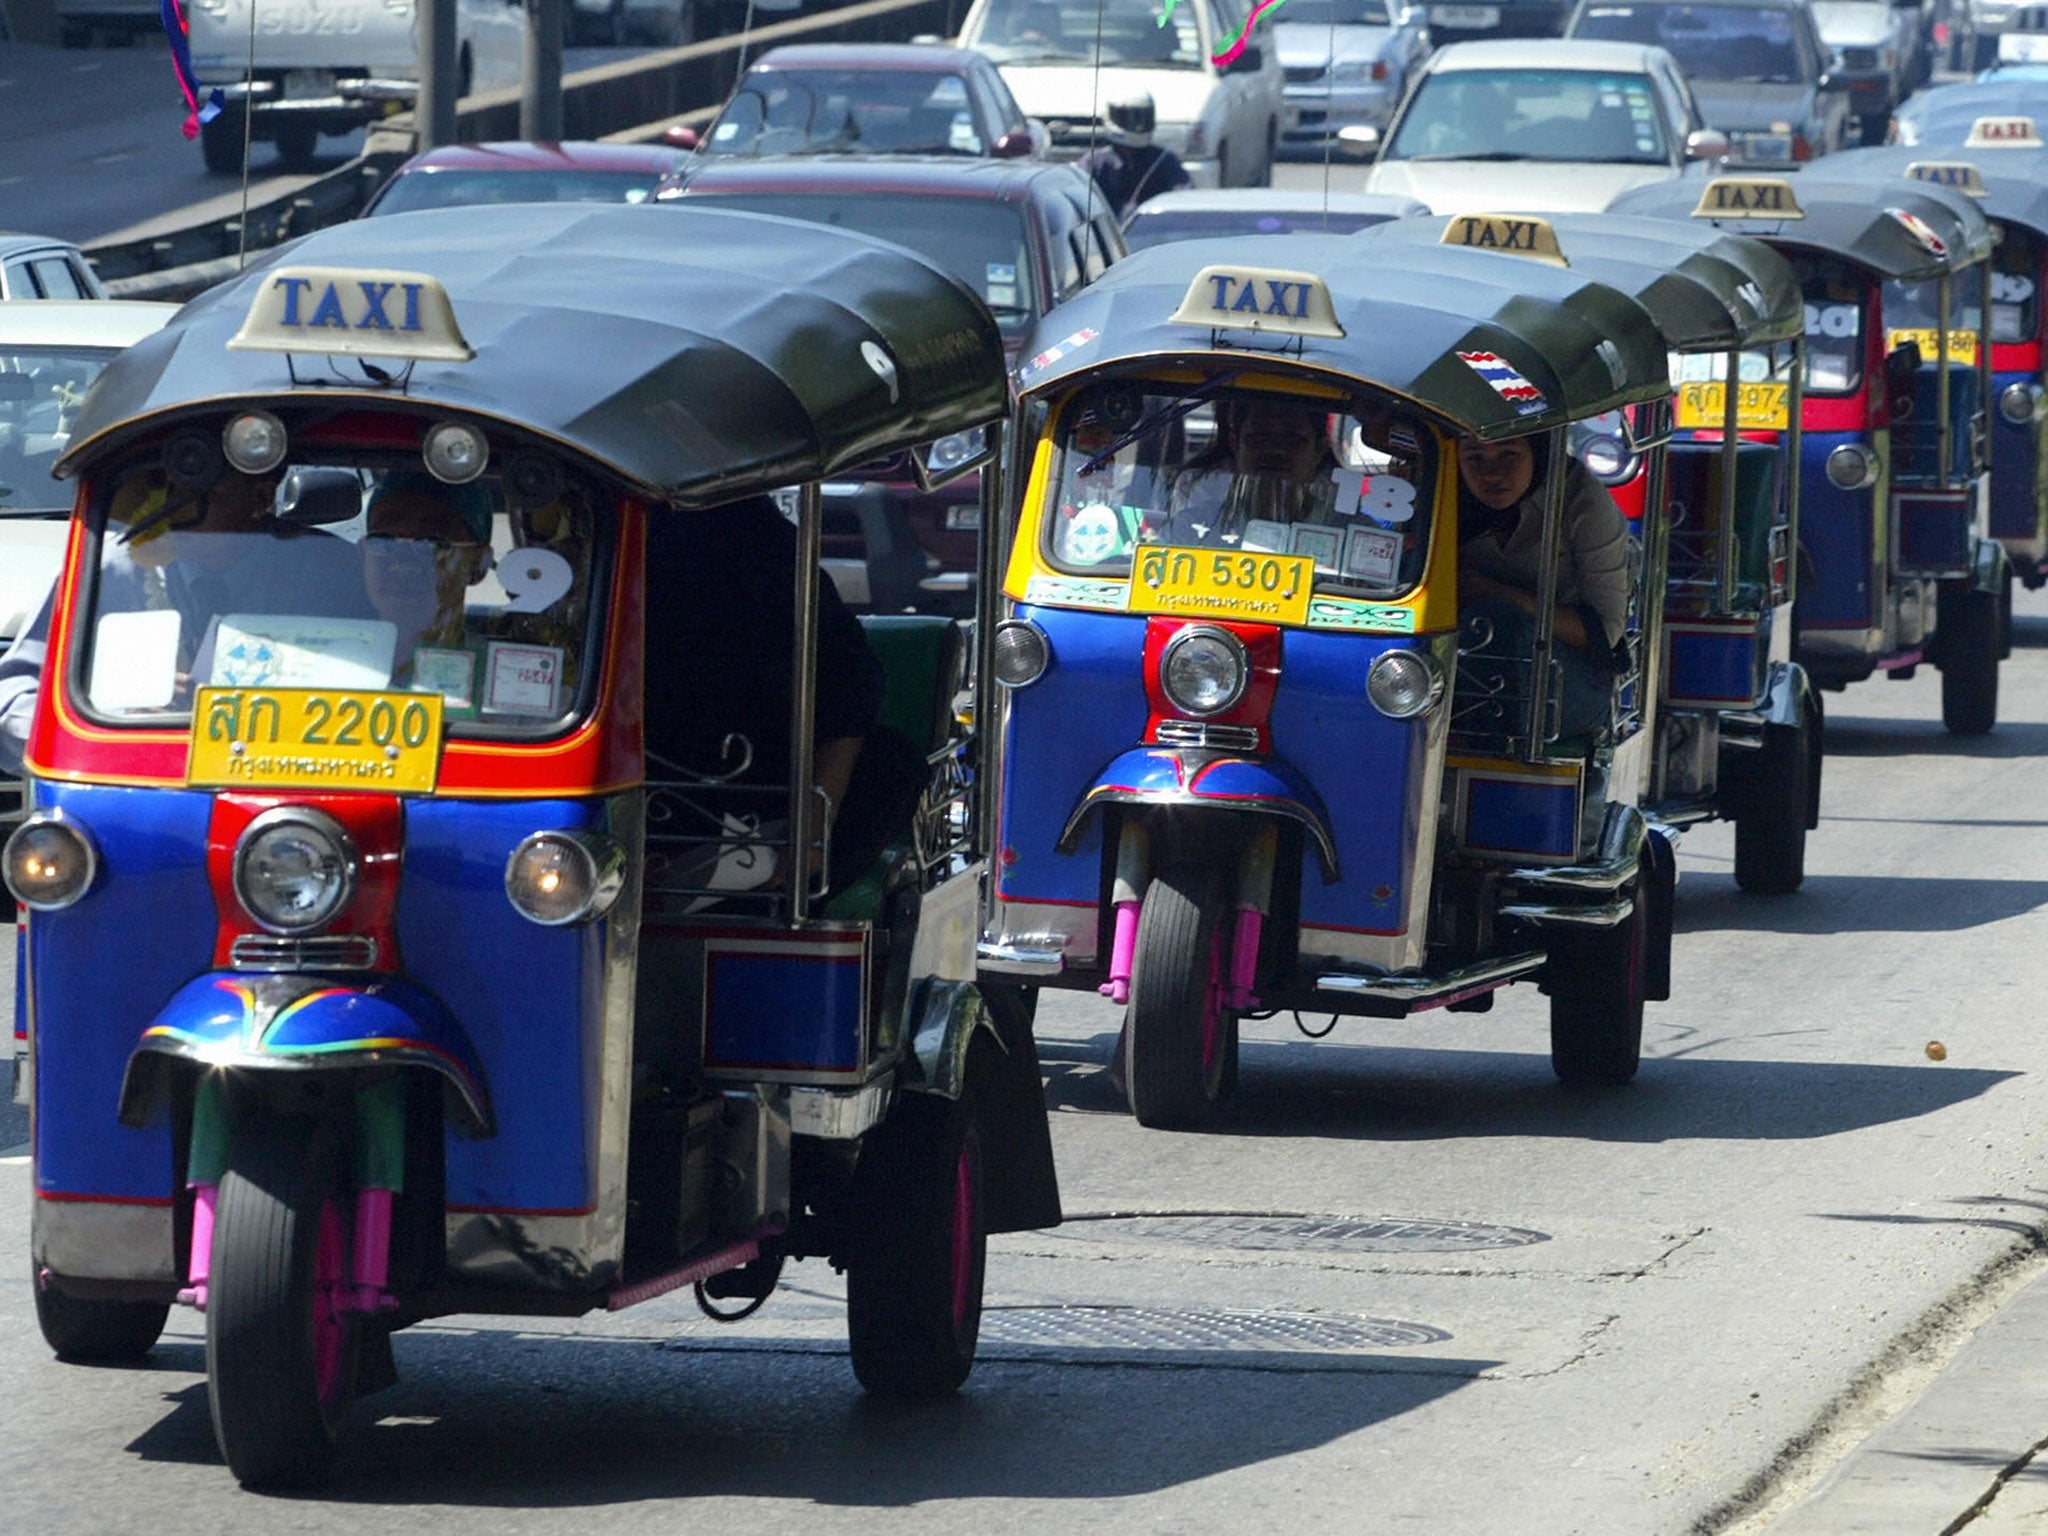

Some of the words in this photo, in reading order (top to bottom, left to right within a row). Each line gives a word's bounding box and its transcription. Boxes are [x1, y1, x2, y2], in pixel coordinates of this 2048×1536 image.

[1981, 122, 2028, 139] TAXI
[1712, 184, 1784, 209] TAXI
[1914, 166, 1971, 187] TAXI
[1459, 217, 1539, 250] TAXI
[272, 277, 424, 331] TAXI
[1208, 274, 1312, 318] TAXI
[1330, 467, 1417, 522] 18
[496, 546, 574, 614] 9
[1143, 547, 1197, 585] สก
[1211, 553, 1302, 595] 5301
[208, 689, 280, 742] สก
[301, 695, 430, 748] 2200
